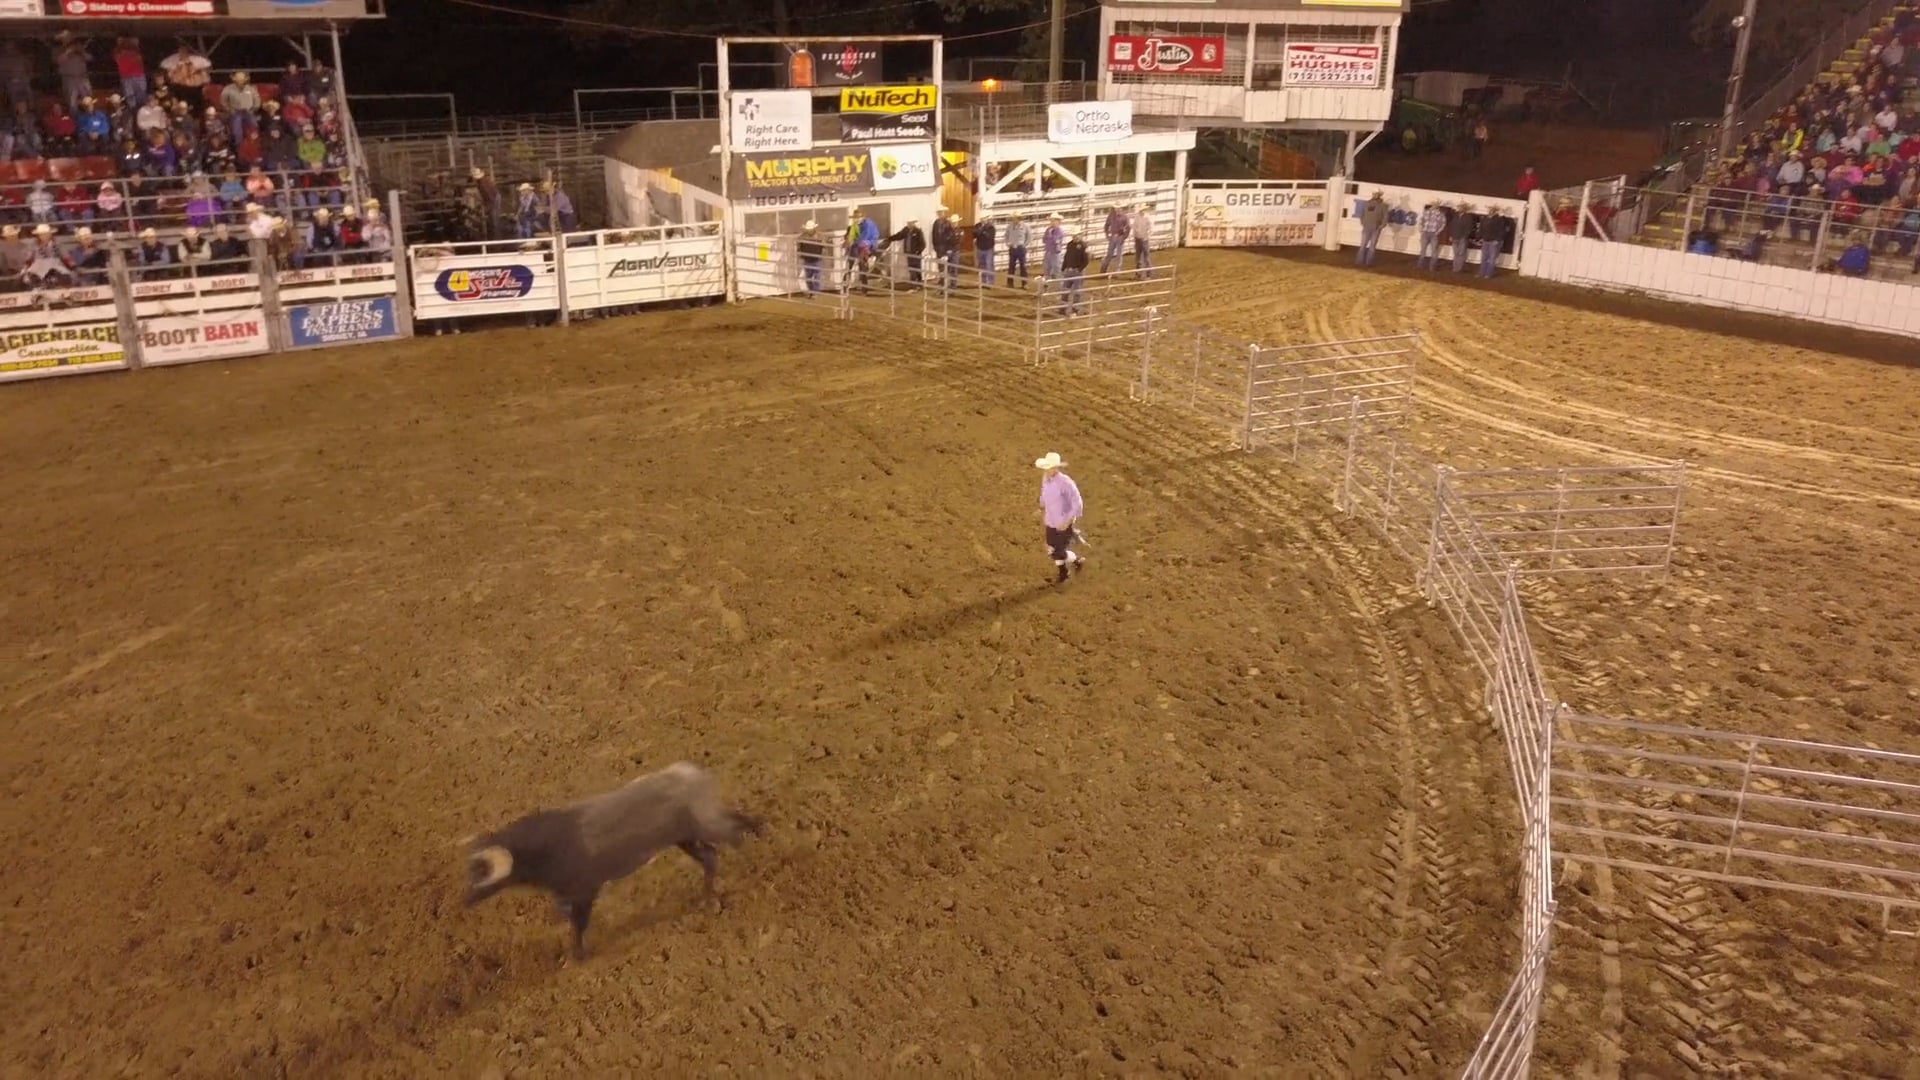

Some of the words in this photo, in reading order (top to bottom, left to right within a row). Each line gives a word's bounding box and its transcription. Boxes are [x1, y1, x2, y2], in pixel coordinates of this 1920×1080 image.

[1138, 39, 1188, 70] Justin
[1290, 60, 1374, 70] HUGHES
[848, 88, 928, 108] NuTech
[1076, 110, 1110, 122] Ortho
[746, 125, 773, 137] Right
[776, 124, 800, 134] Care.
[1076, 120, 1129, 134] Nebraska
[745, 138, 771, 149] Right
[773, 137, 800, 146] Here.
[745, 154, 868, 180] MURPHY
[750, 178, 788, 188] TRACTOR
[1226, 192, 1297, 206] GREEDY
[321, 301, 374, 316] FIRST
[301, 309, 384, 329] EXPRESS
[144, 327, 200, 348] BOOT
[203, 321, 259, 342] BARN
[306, 321, 382, 337] INSURANCE
